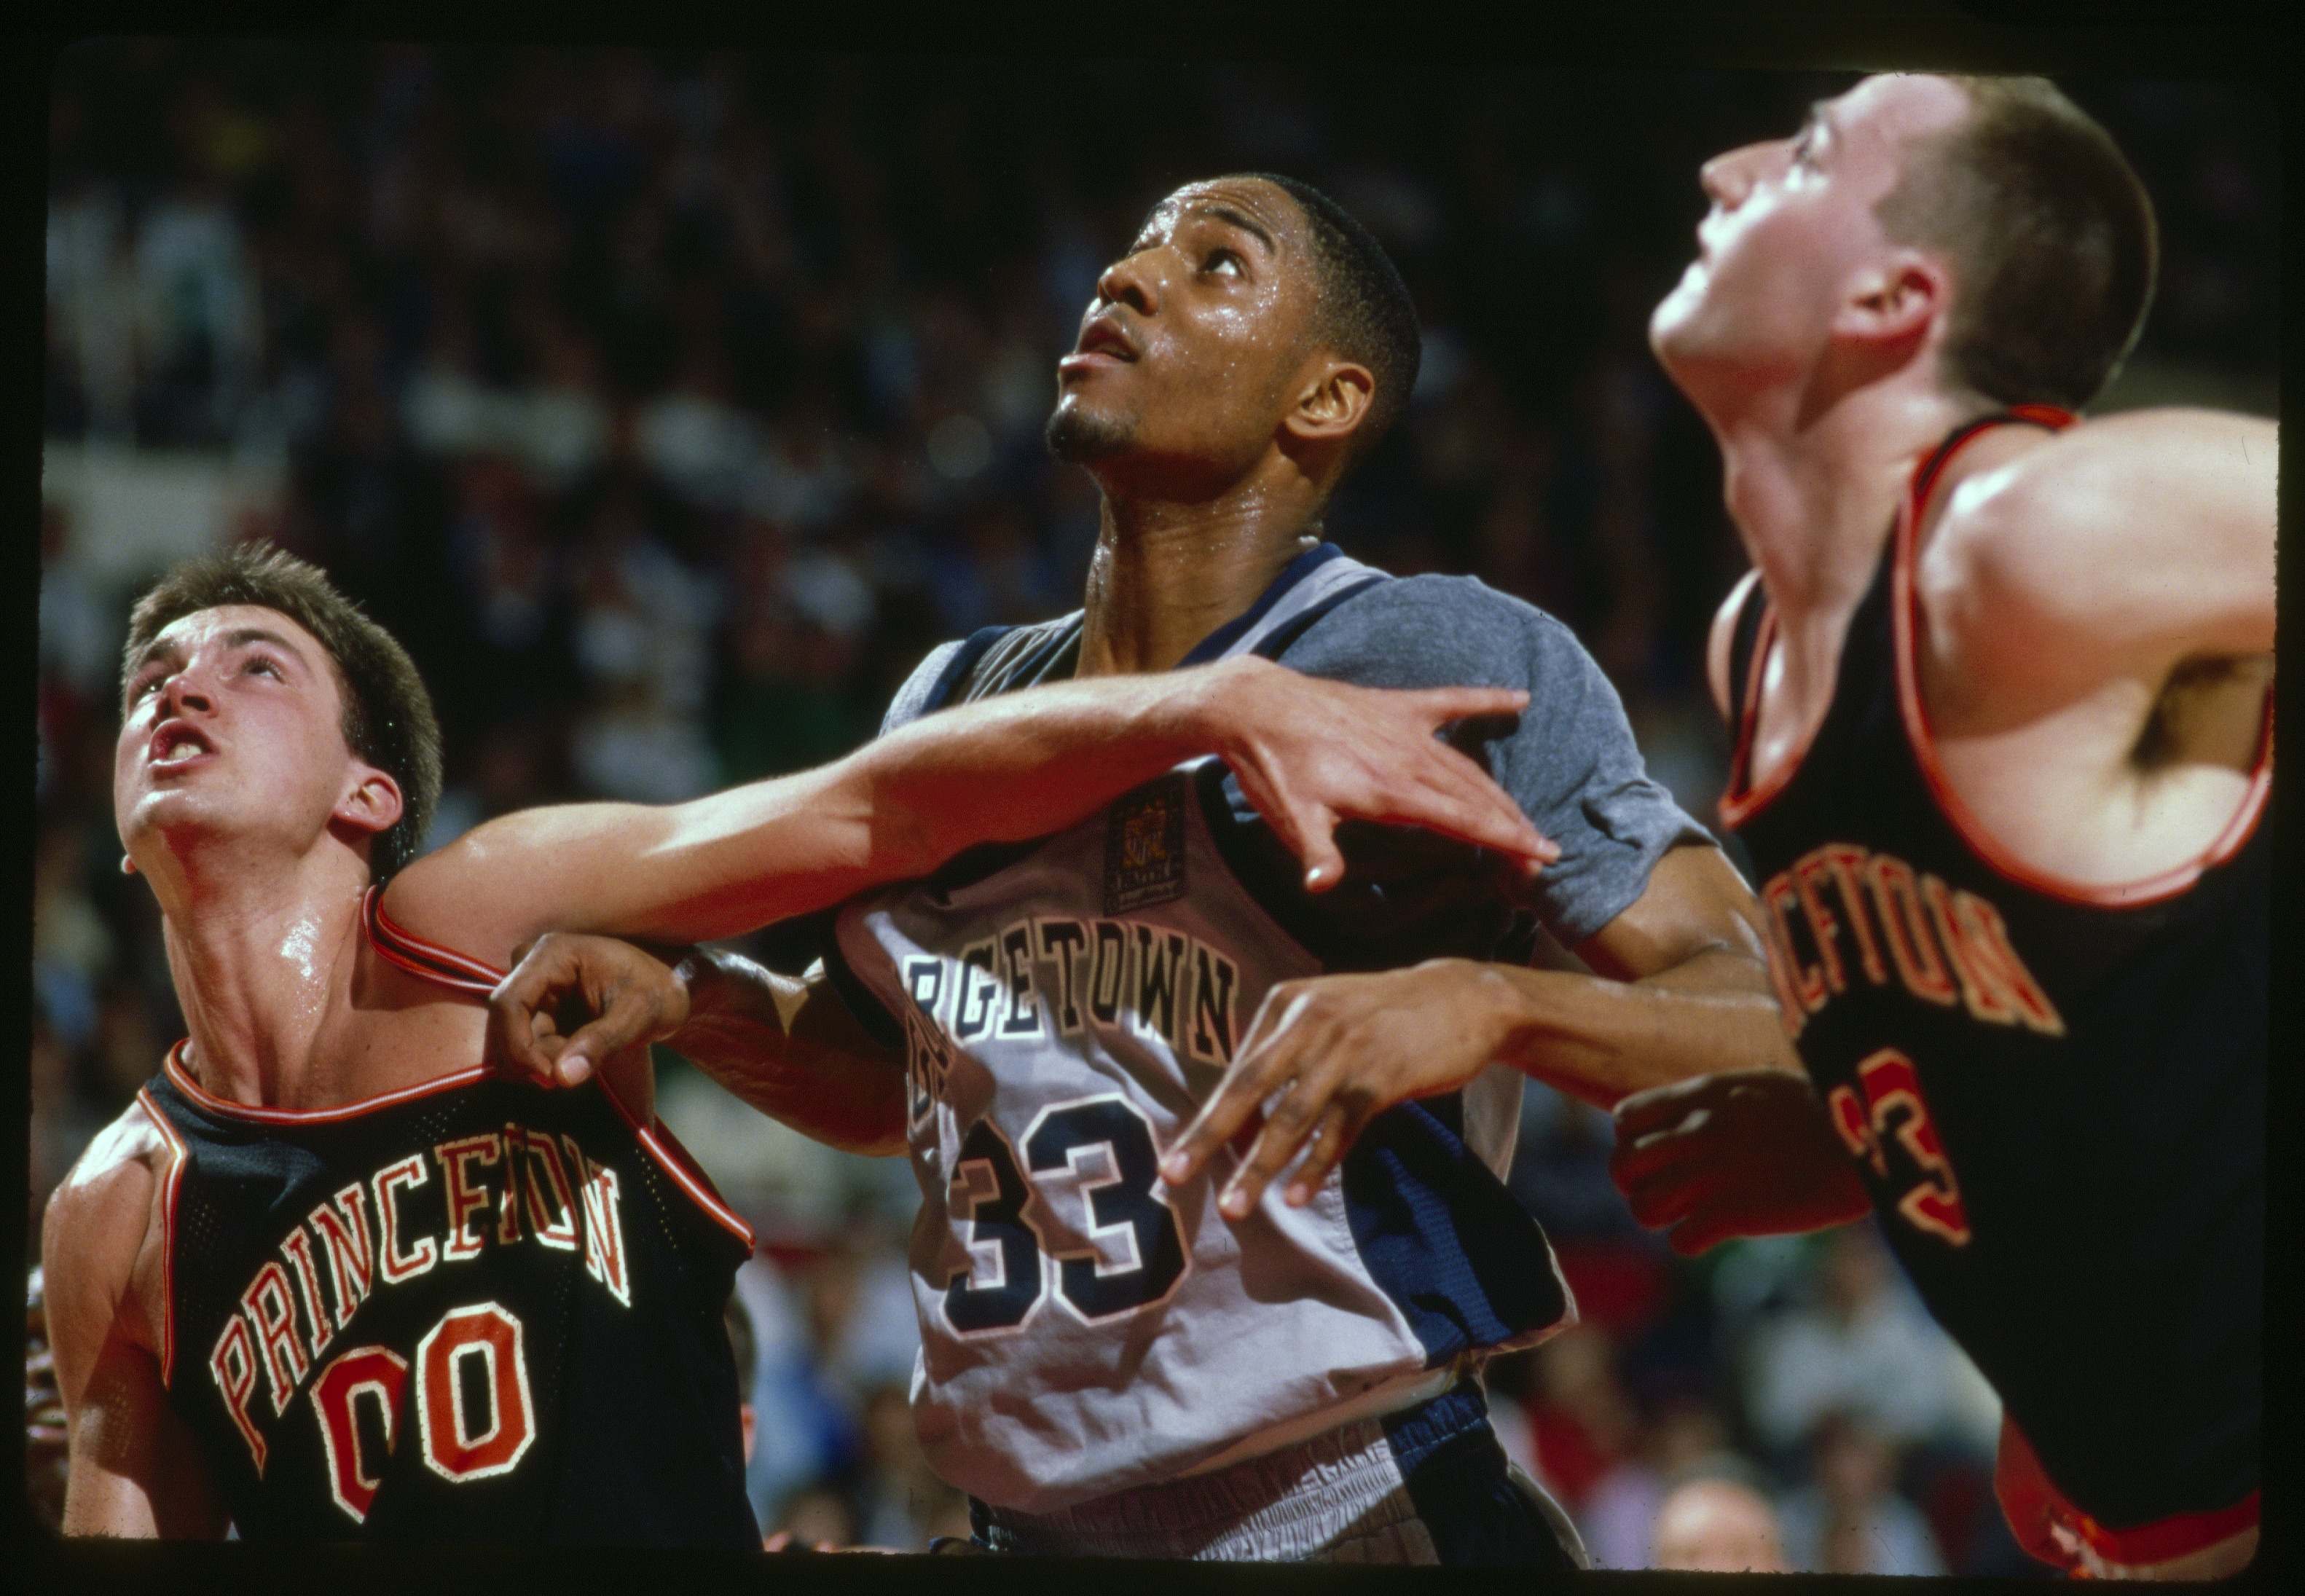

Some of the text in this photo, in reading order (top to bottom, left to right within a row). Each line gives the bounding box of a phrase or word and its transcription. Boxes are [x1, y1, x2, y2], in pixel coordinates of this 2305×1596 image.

[210, 1123, 631, 1481] PRINCETON
[940, 1092, 1193, 1340] 33
[310, 1301, 536, 1524] 00
